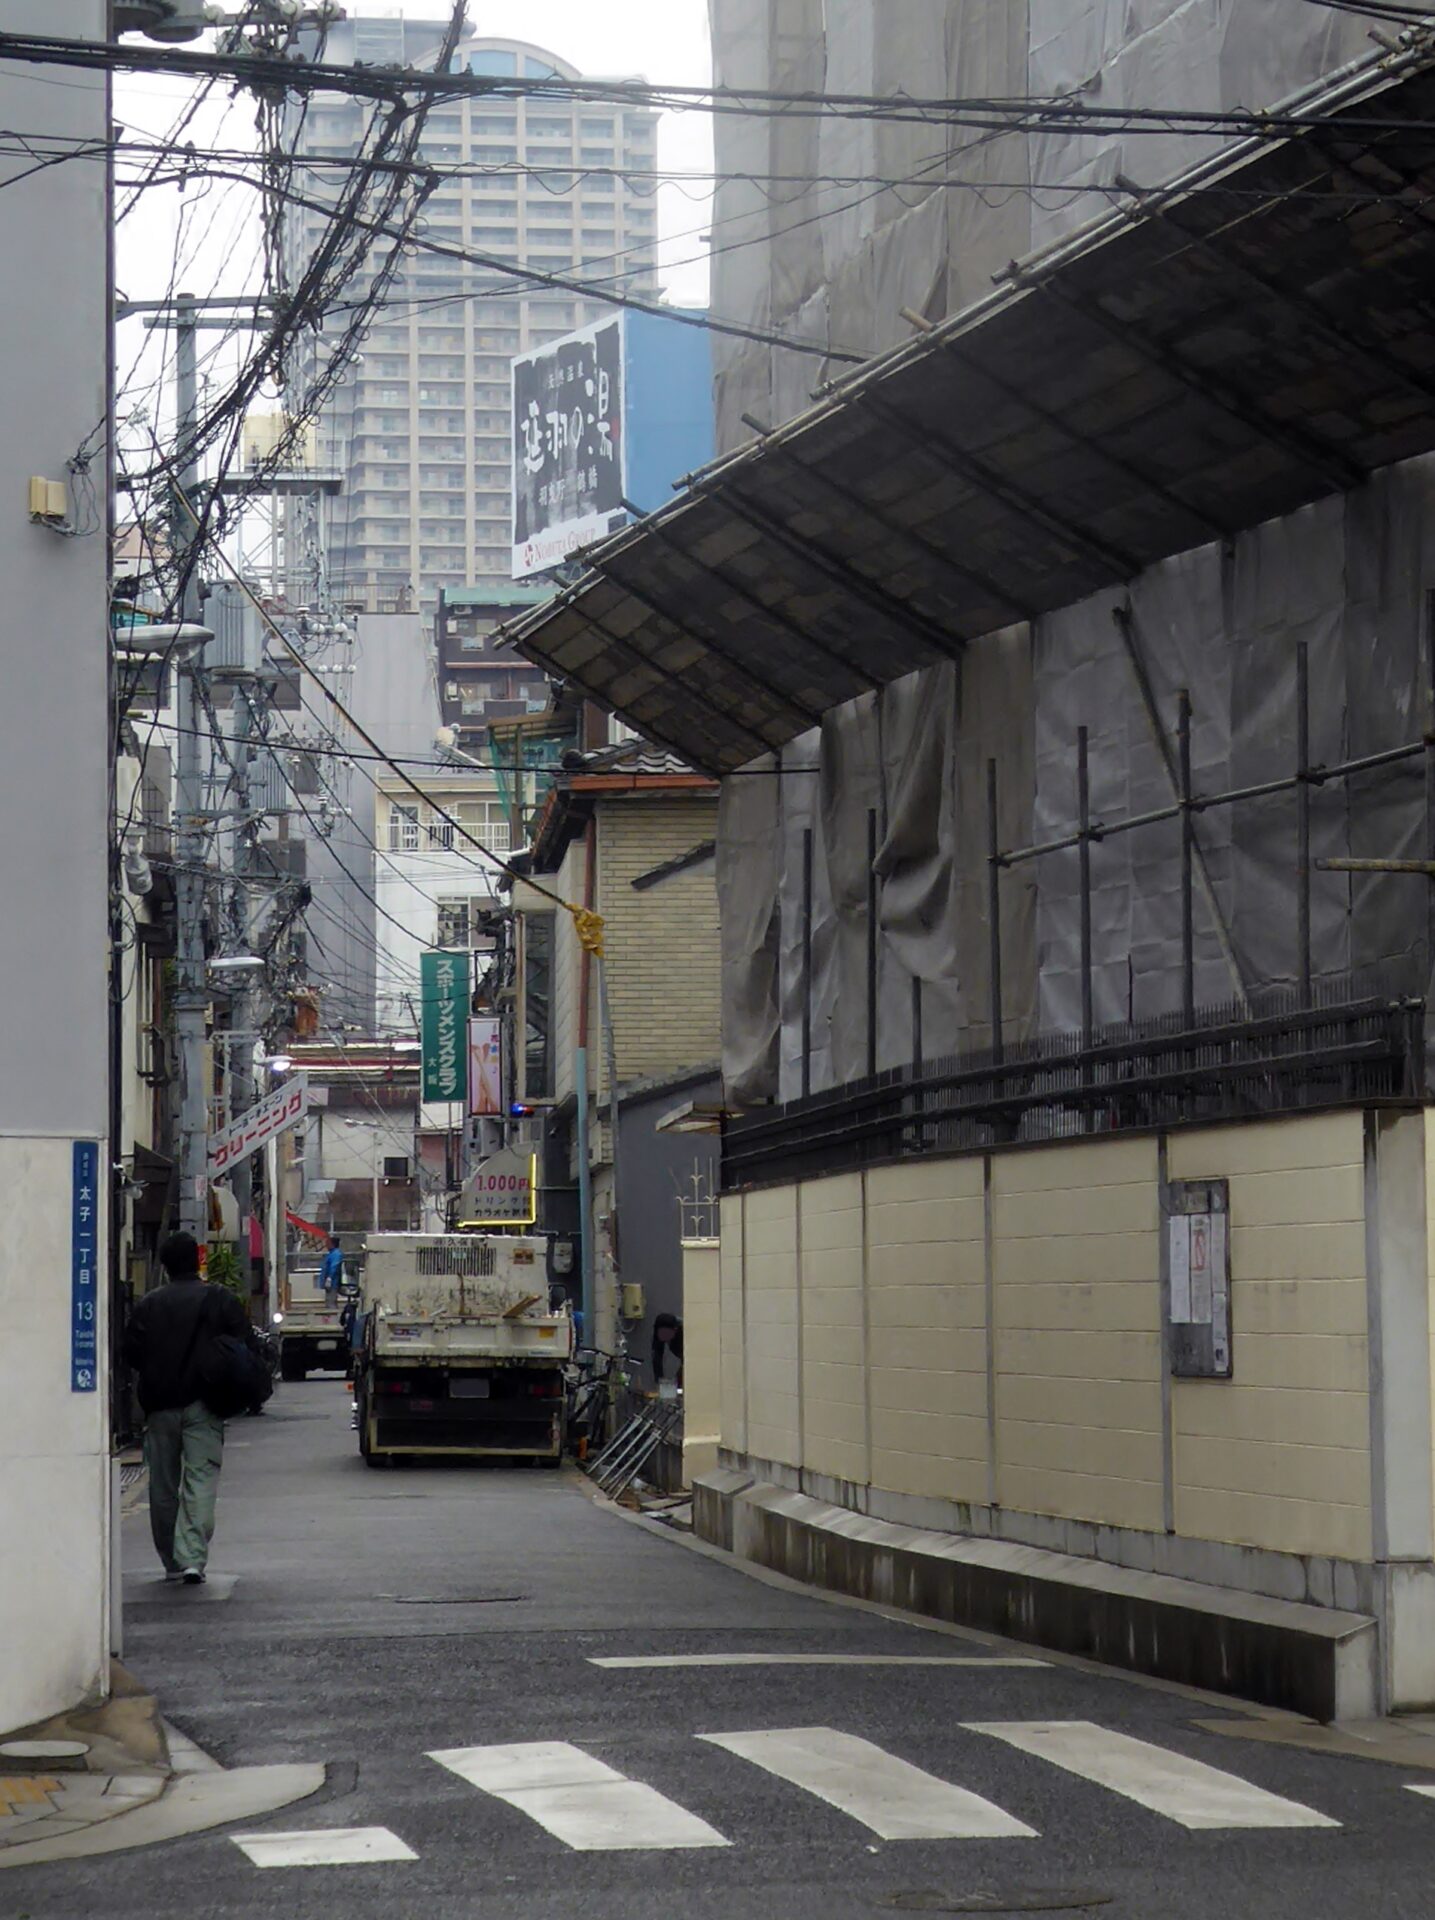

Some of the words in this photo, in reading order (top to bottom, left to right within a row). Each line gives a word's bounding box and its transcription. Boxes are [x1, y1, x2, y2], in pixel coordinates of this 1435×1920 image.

[214, 1088, 303, 1168] クリーニング
[79, 1185, 92, 1285] 太子一丁目
[76, 1300, 93, 1321] 13
